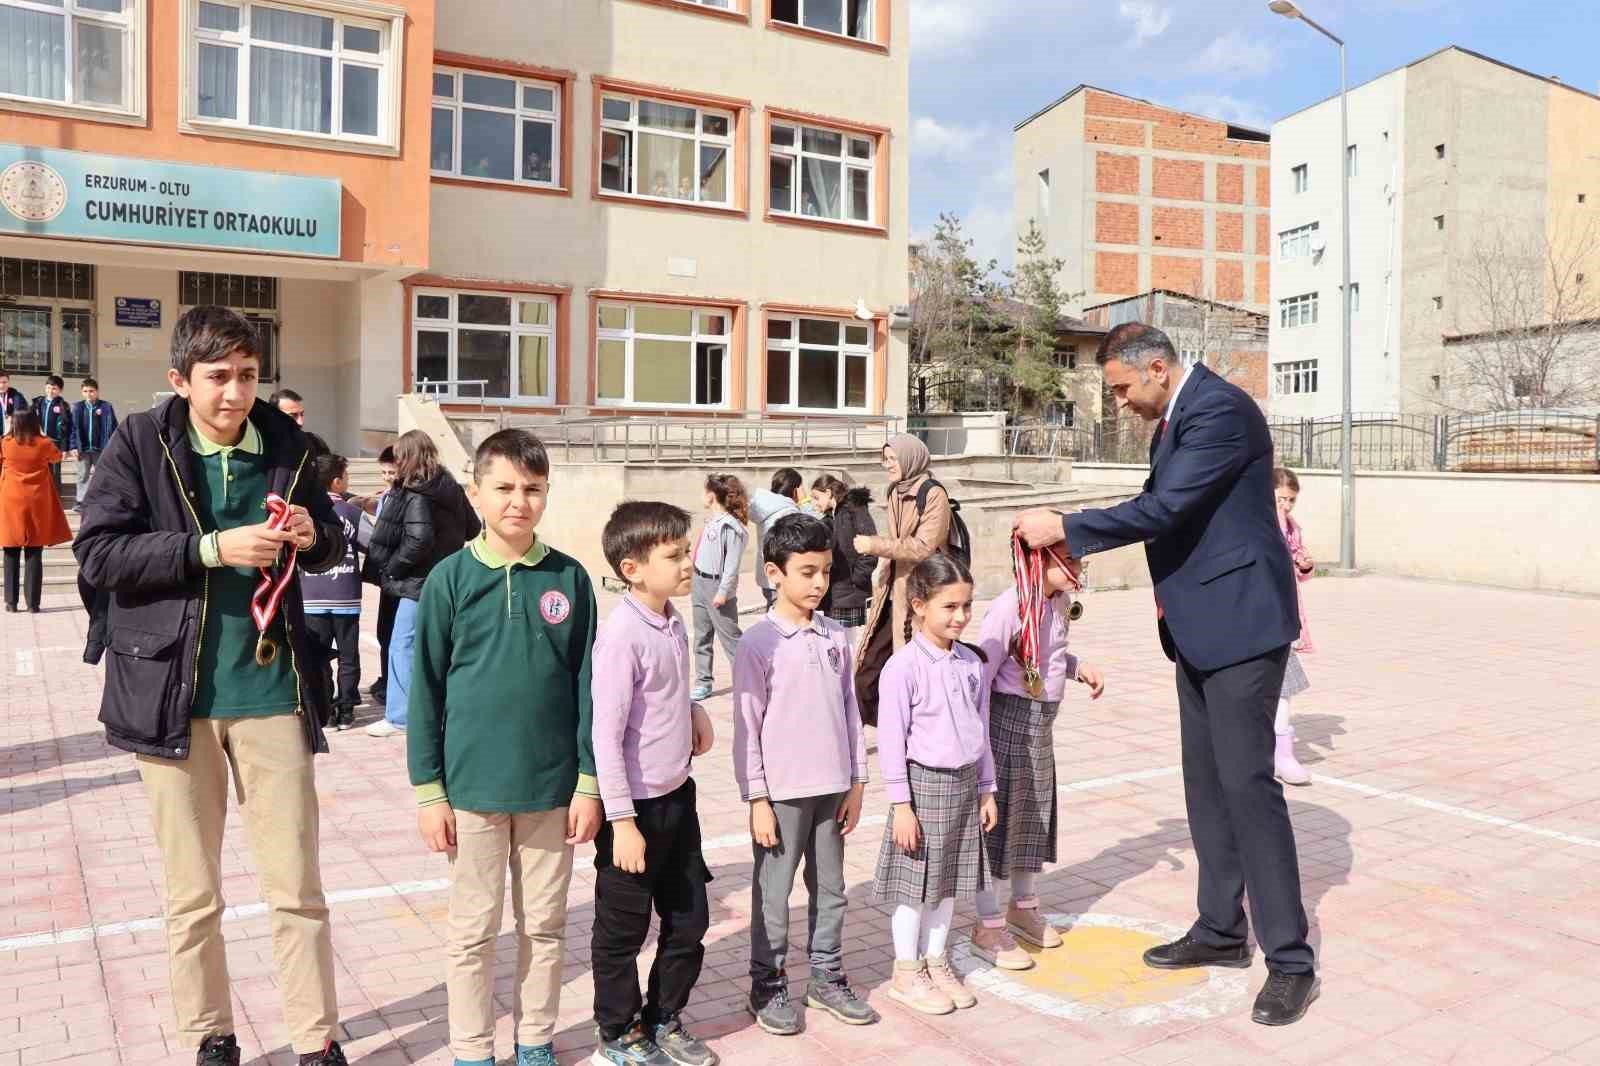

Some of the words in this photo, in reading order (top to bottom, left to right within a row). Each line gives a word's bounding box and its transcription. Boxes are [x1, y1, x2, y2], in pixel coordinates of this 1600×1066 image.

[85, 174, 147, 192] ERZURUM
[159, 181, 190, 196] OLTU
[85, 199, 208, 230] CUMHURİYET
[213, 211, 317, 238] ORTAOKULU
